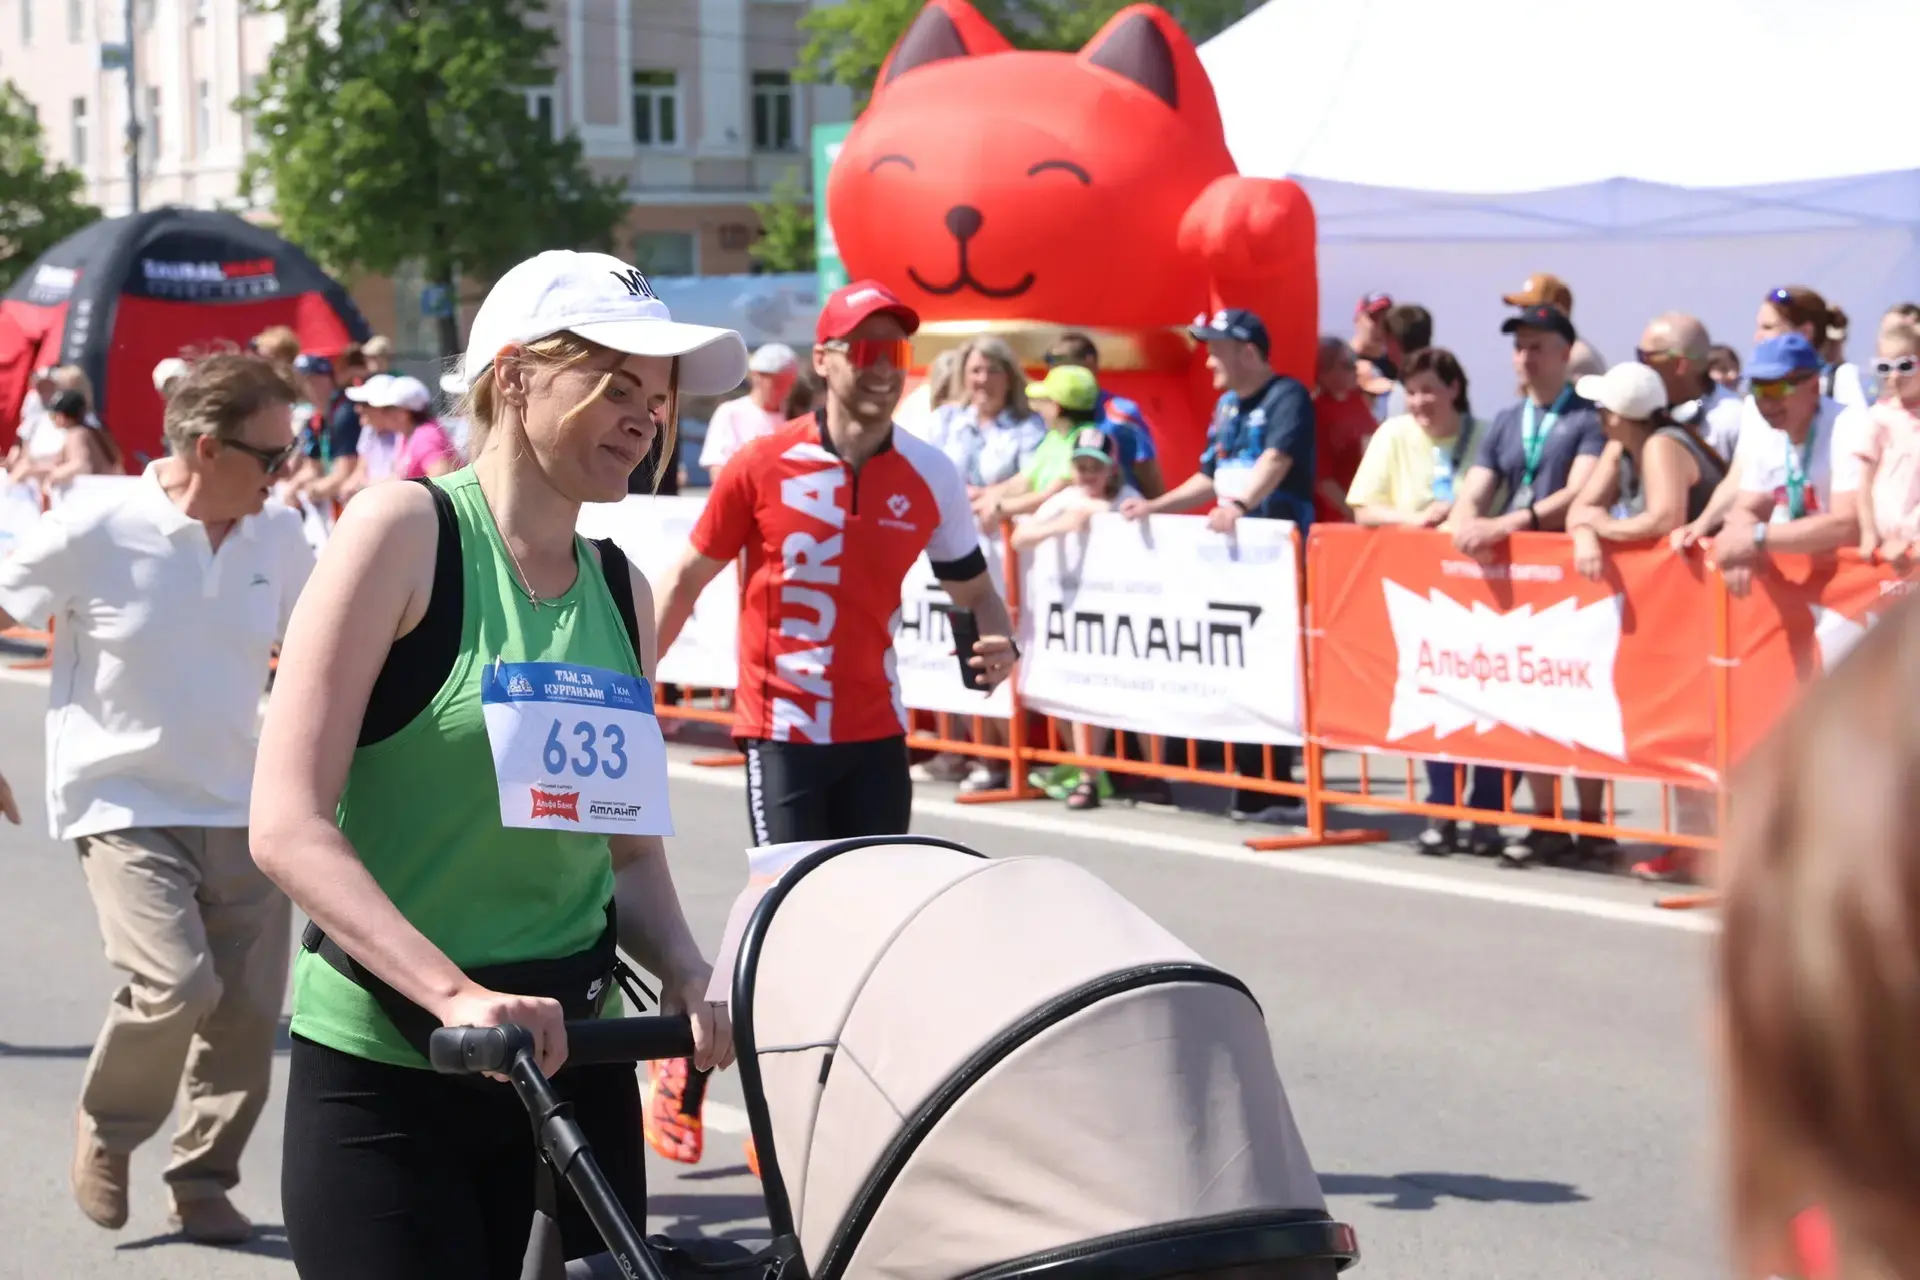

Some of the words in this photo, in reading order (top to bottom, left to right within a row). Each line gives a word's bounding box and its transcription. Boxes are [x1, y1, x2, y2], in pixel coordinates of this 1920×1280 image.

[555, 670, 580, 685] ТАМ,
[581, 673, 594, 686] ЗА
[1417, 638, 1511, 686] Альфа
[1518, 645, 1594, 690] Банк
[544, 683, 605, 700] КУРГАНАМИ
[543, 718, 628, 779] 633
[747, 745, 770, 848] AURALMA
